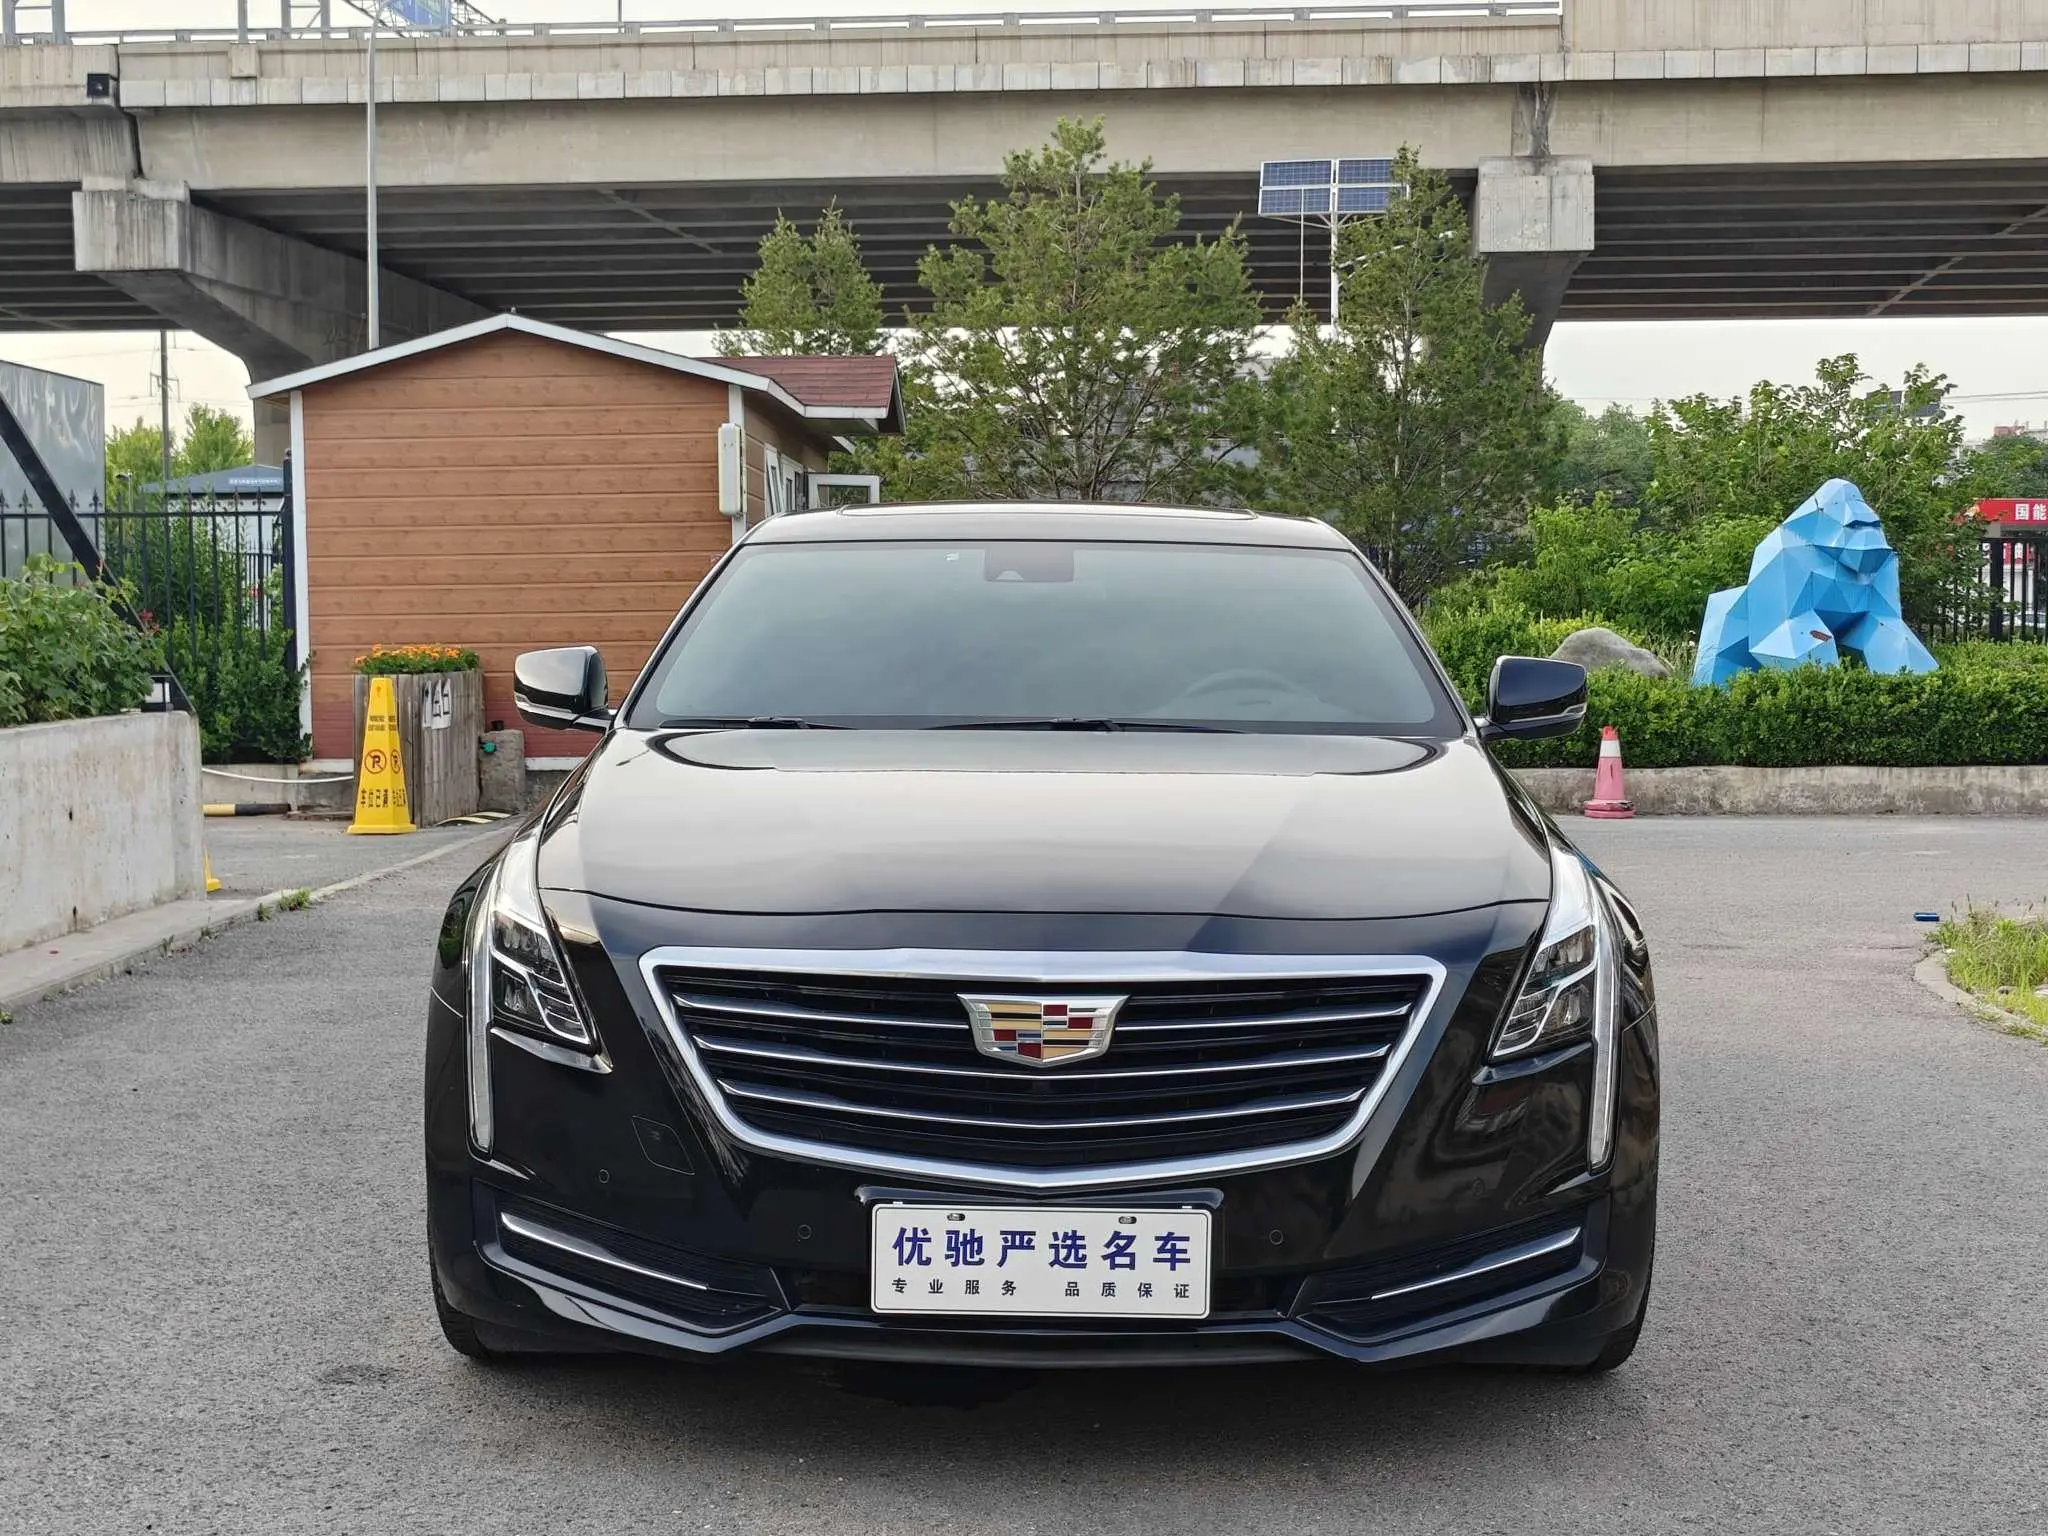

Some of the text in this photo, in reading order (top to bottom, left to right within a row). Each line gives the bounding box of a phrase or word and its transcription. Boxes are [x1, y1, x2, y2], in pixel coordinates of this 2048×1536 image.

[2015, 503, 2047, 520] 国能
[892, 1226, 1191, 1272] 优驰严选名车
[891, 1277, 1190, 1299] 专业服务 品质保证
